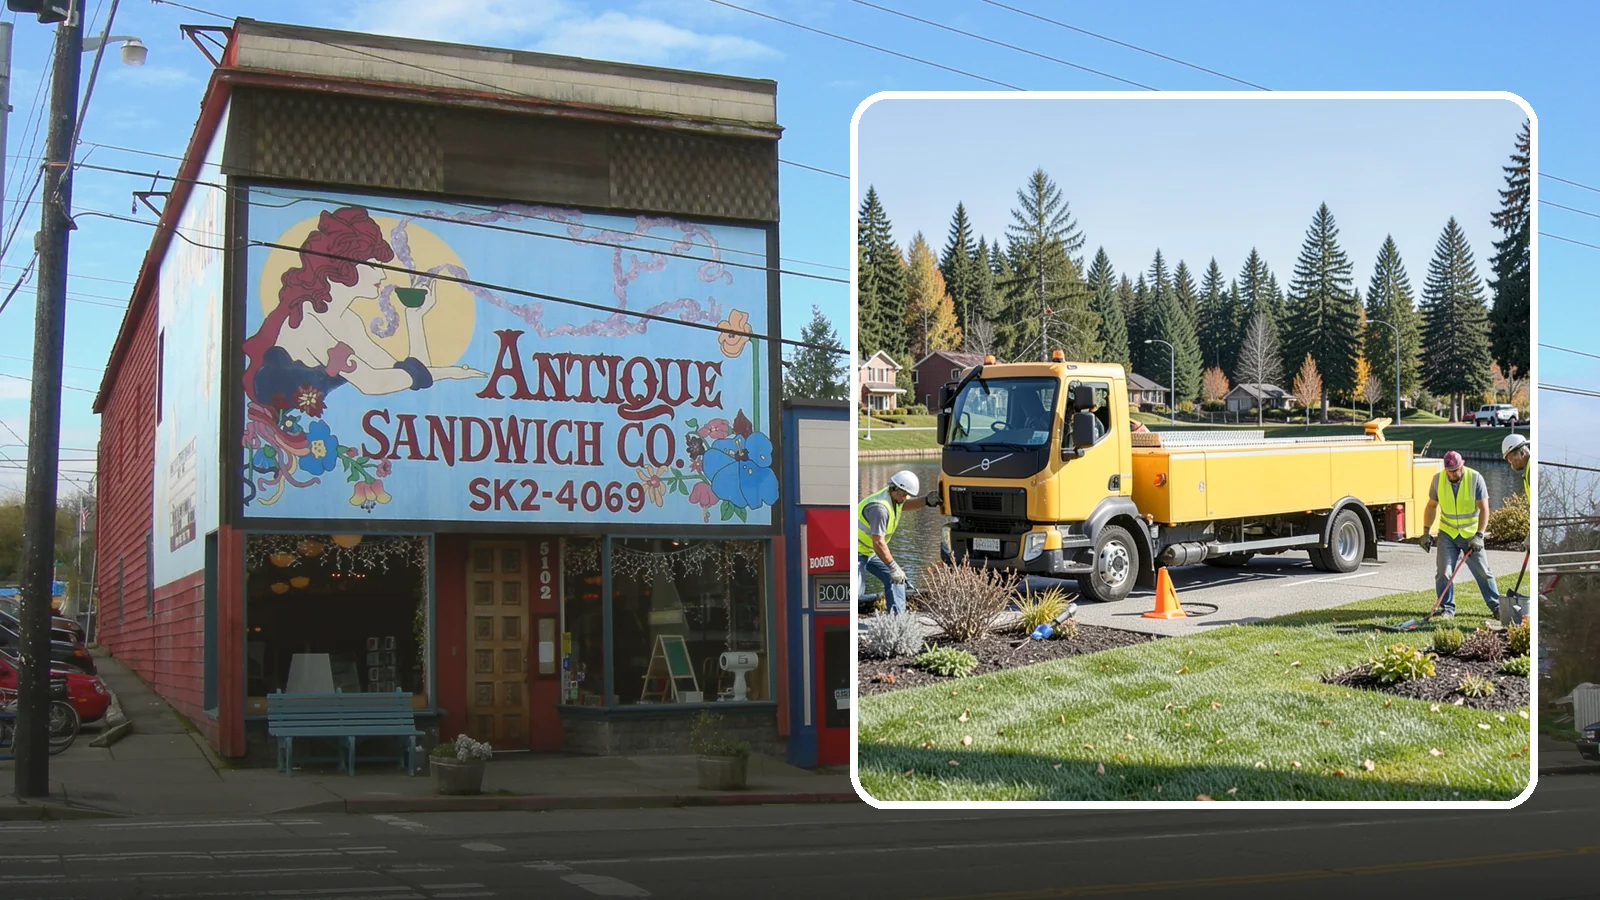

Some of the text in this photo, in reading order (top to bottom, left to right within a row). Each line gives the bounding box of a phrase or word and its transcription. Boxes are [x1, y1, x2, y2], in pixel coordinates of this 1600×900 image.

[475, 329, 723, 421] ANTIQUE
[361, 408, 685, 469] SANDWICH CO.
[468, 476, 645, 513] SK2-4069
[540, 541, 551, 600] 5102
[809, 555, 835, 569] BOOKS
